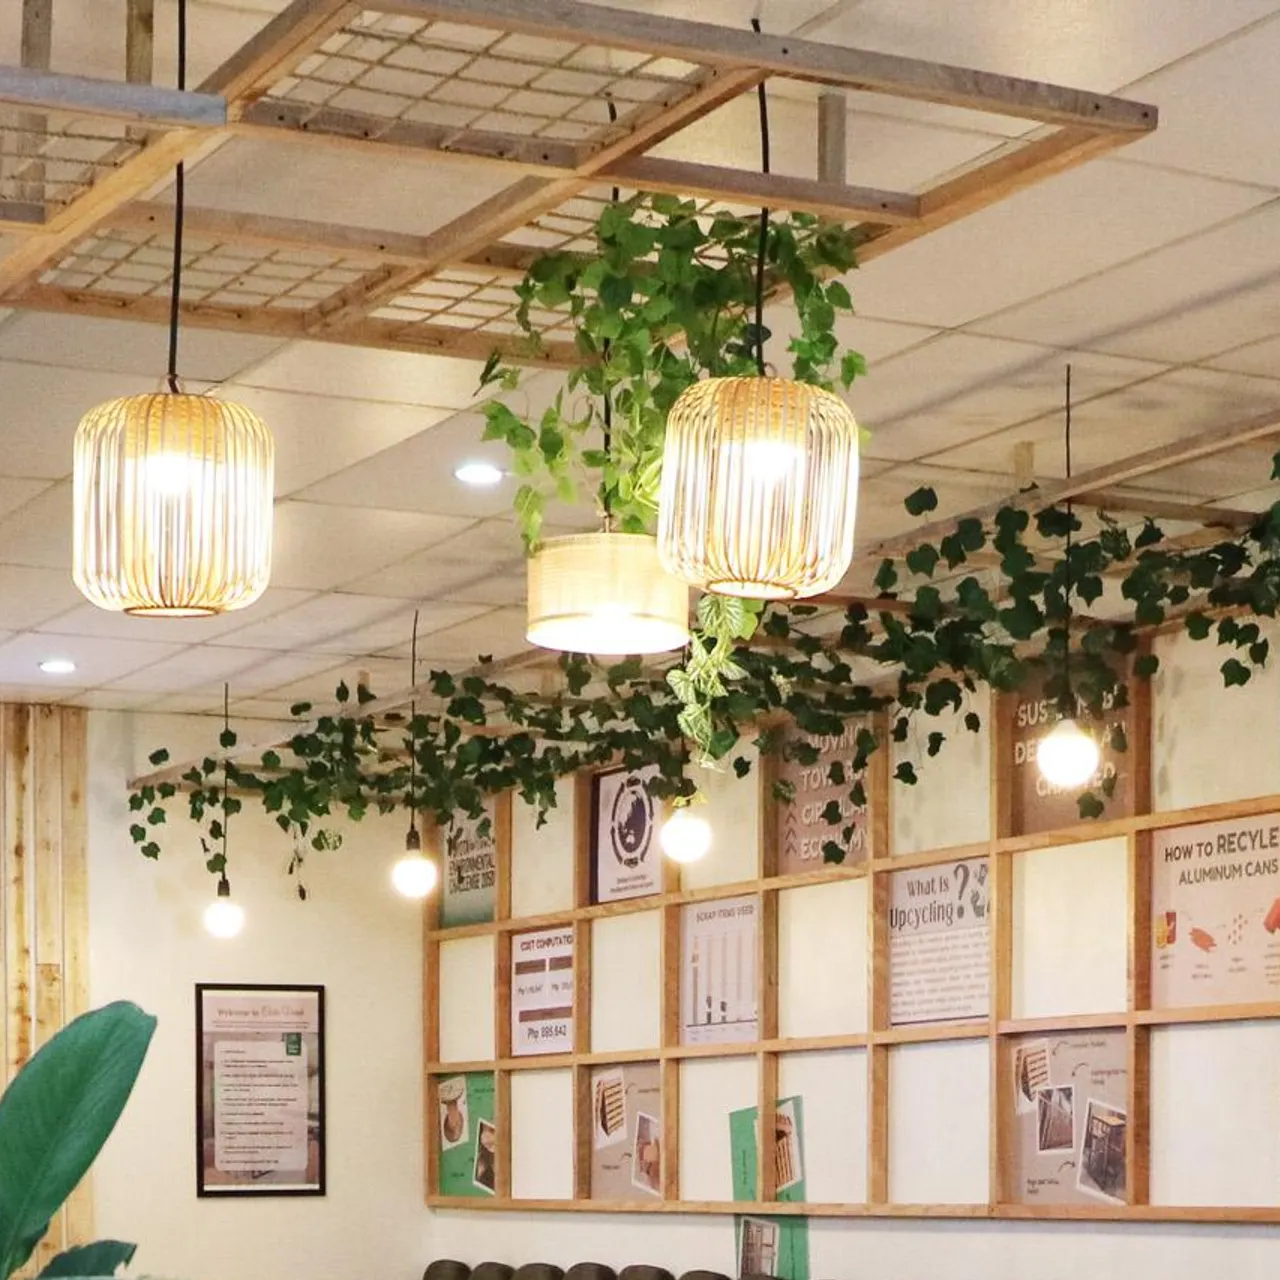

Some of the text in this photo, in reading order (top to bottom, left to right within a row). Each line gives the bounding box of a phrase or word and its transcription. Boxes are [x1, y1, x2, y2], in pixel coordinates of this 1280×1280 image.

[1164, 826, 1280, 862] HOW TO RECYLE
[907, 876, 937, 897] What
[1178, 858, 1279, 886] ALUMINUM CANS
[890, 900, 954, 931] Upcycling
